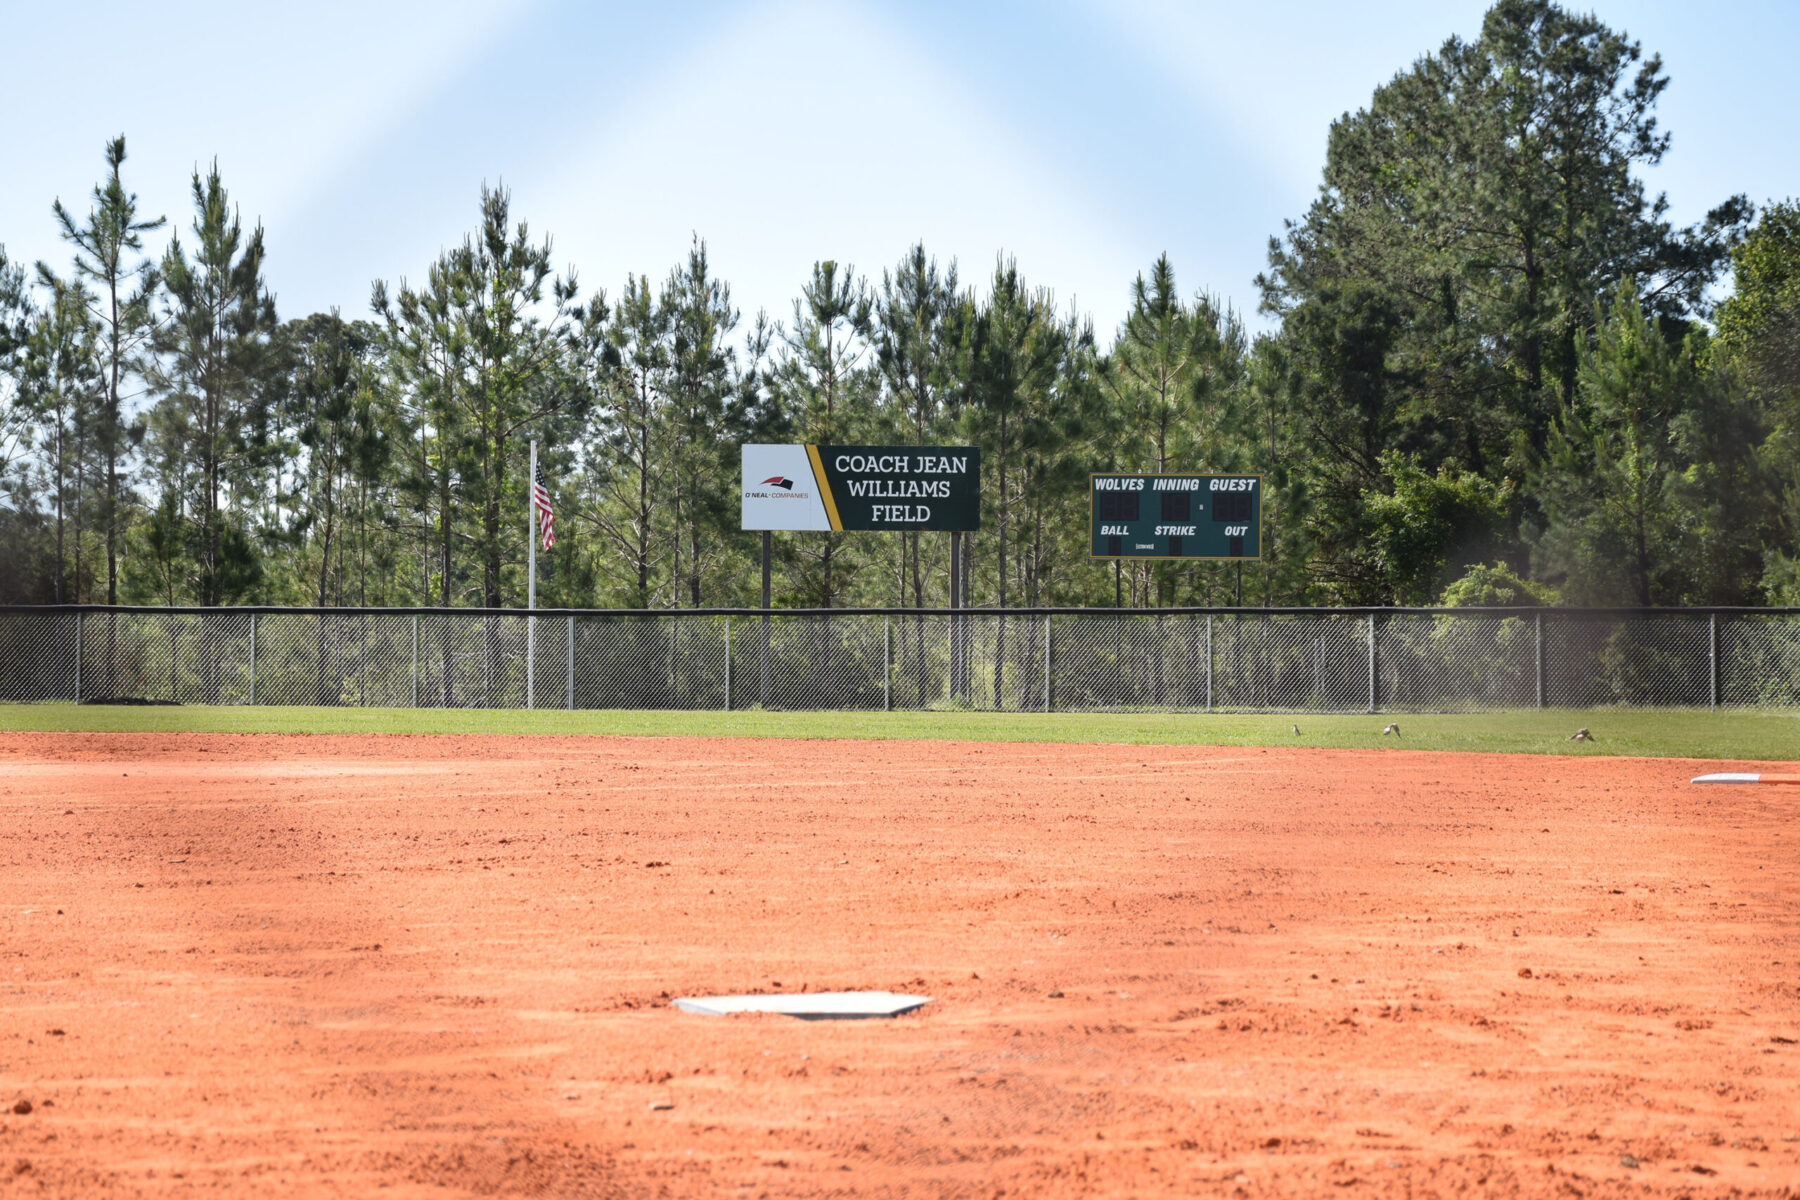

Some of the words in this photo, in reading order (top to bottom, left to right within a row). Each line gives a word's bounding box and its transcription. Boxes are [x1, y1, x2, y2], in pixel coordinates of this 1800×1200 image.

[835, 455, 909, 473] COACH
[914, 456, 968, 474] JEAN
[847, 480, 951, 498] WILLIAMS
[1095, 478, 1145, 491] WOLVES
[1152, 478, 1199, 491] INNING
[1209, 478, 1256, 491] GUEST
[871, 504, 931, 522] FIELD
[1100, 525, 1129, 536] BALL
[1154, 525, 1197, 536] STRIKE
[1224, 526, 1248, 536] OUT
